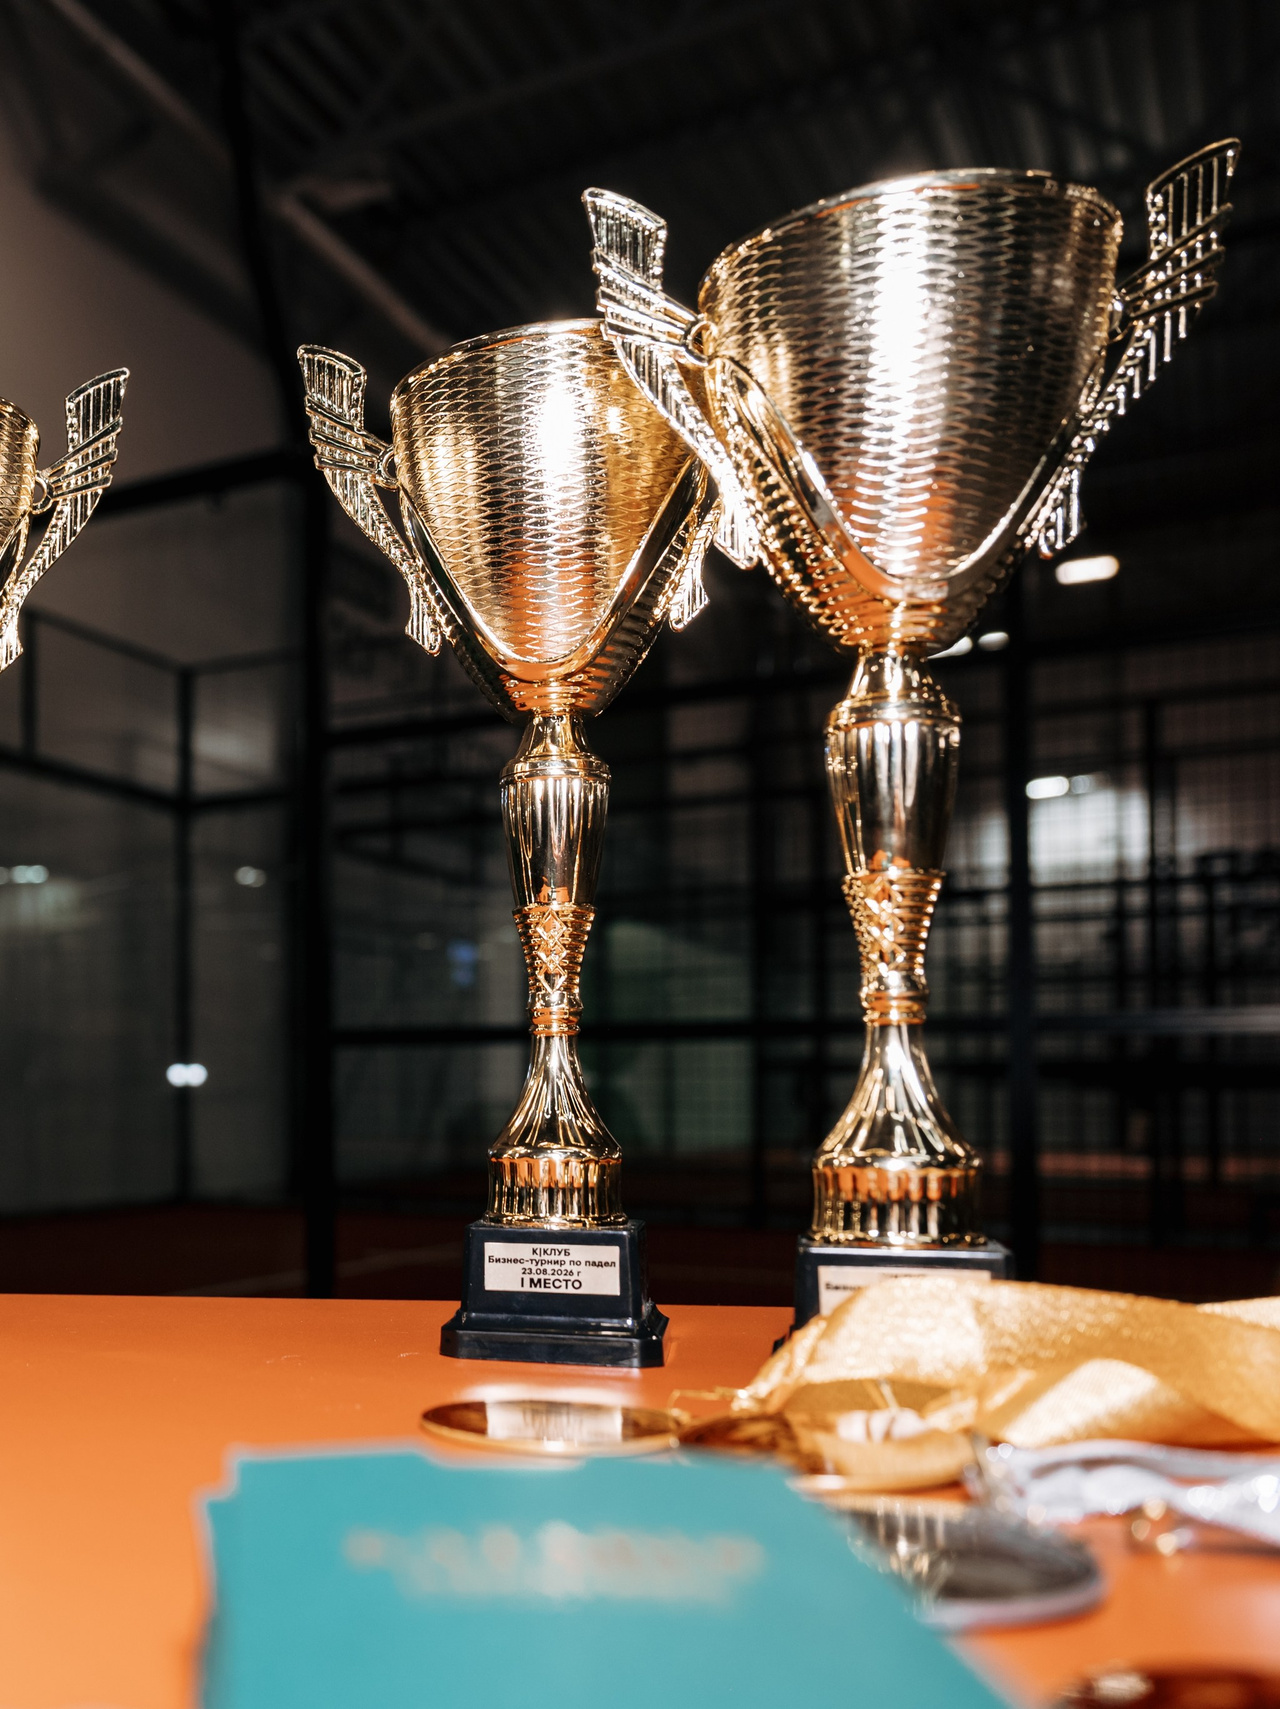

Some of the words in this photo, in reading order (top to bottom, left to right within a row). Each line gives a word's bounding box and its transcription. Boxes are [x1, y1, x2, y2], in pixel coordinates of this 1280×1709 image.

[488, 1256, 565, 1267] Бизнес-турнир
[522, 1268, 574, 1276] 23.08.2026
[530, 1278, 582, 1289] МЕСТО
